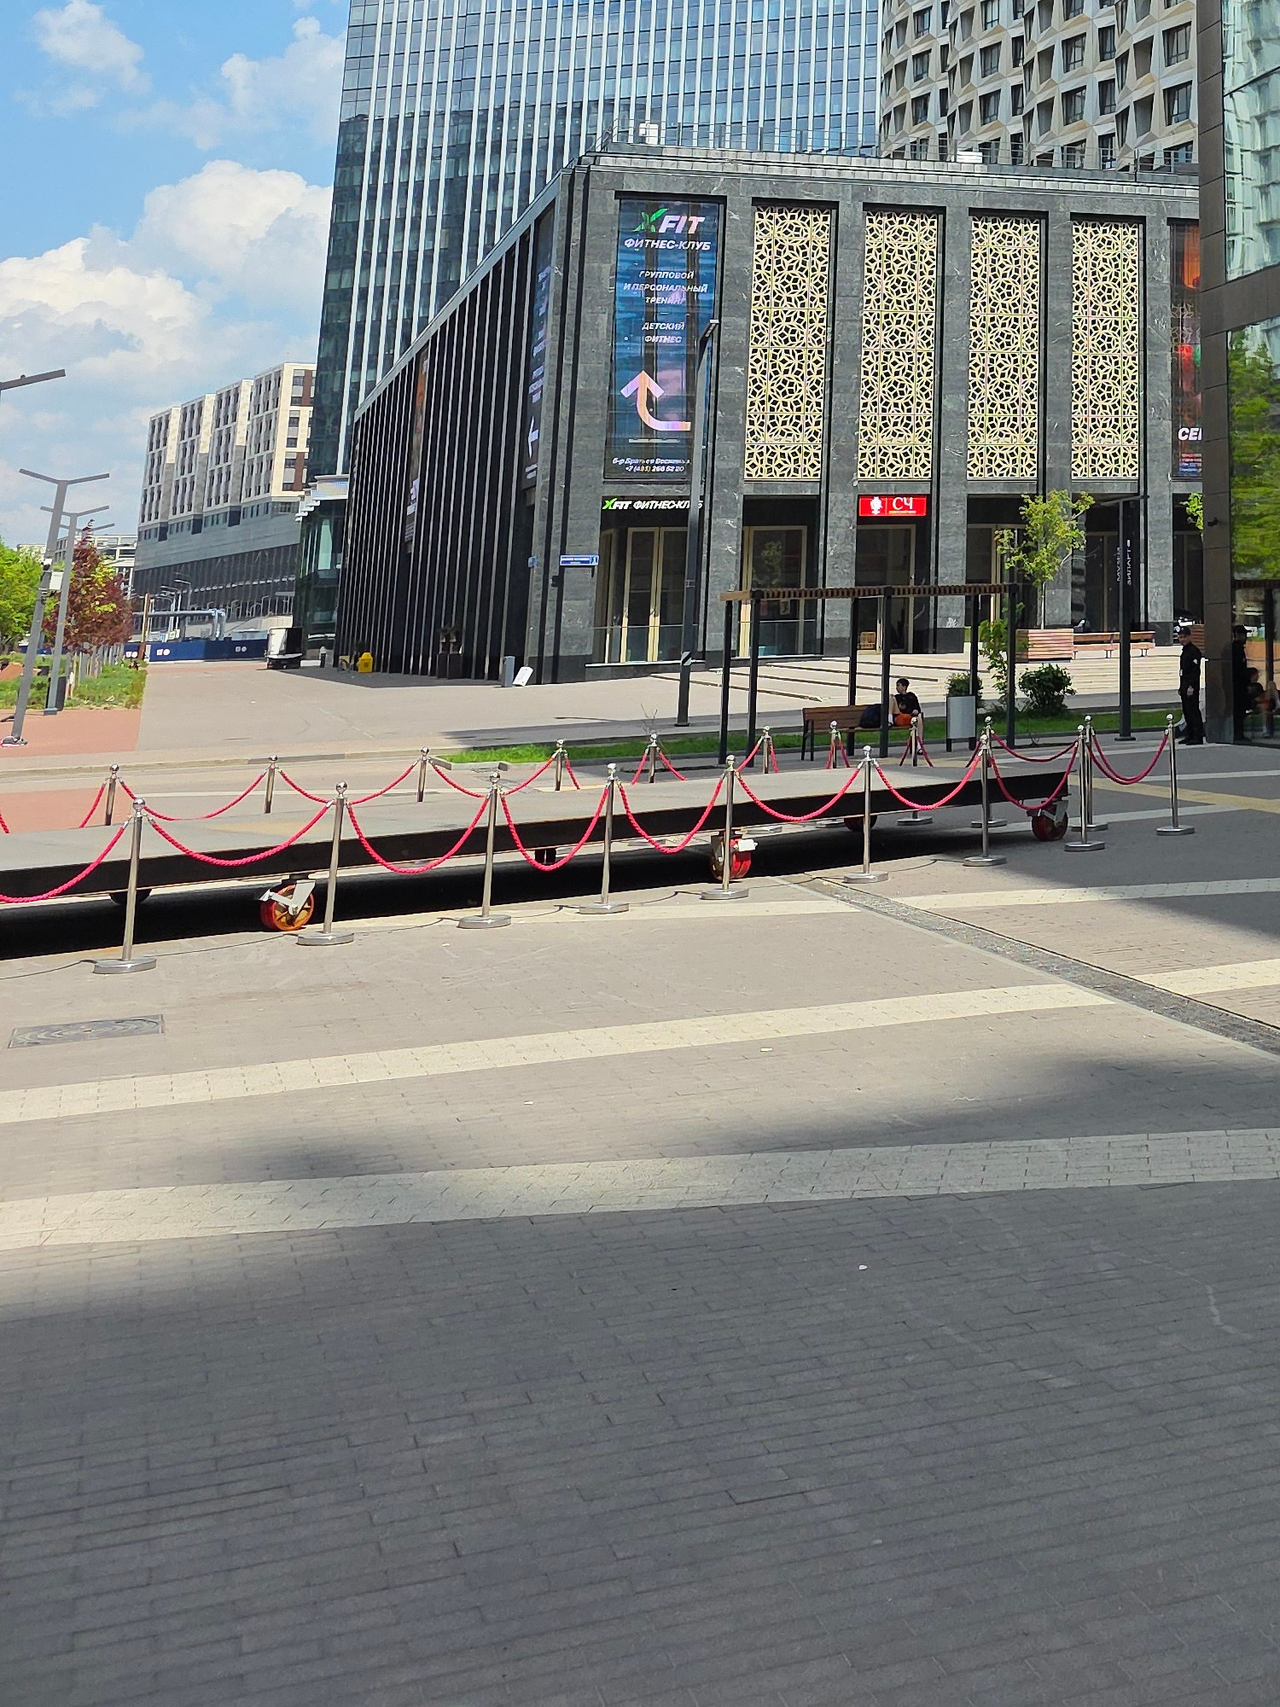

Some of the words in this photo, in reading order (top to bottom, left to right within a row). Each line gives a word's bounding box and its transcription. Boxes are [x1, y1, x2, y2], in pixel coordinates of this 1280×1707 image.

[632, 207, 705, 234] XFIT
[624, 238, 711, 251] ФИТНЕС-КЛУБ
[639, 270, 695, 280] ГРУППОВОЙ
[623, 282, 631, 291] И
[631, 282, 709, 293] ПЕРСОНАЛЬНЫЙ
[645, 296, 687, 305] ТРЕНИНГ
[641, 322, 685, 331] ДЕТСКИЙ
[644, 335, 682, 344] ФИТНЕС
[602, 498, 632, 509] XFIT
[633, 500, 704, 509] ФИТНЕС-КЛБ
[892, 496, 914, 510] СЧ
